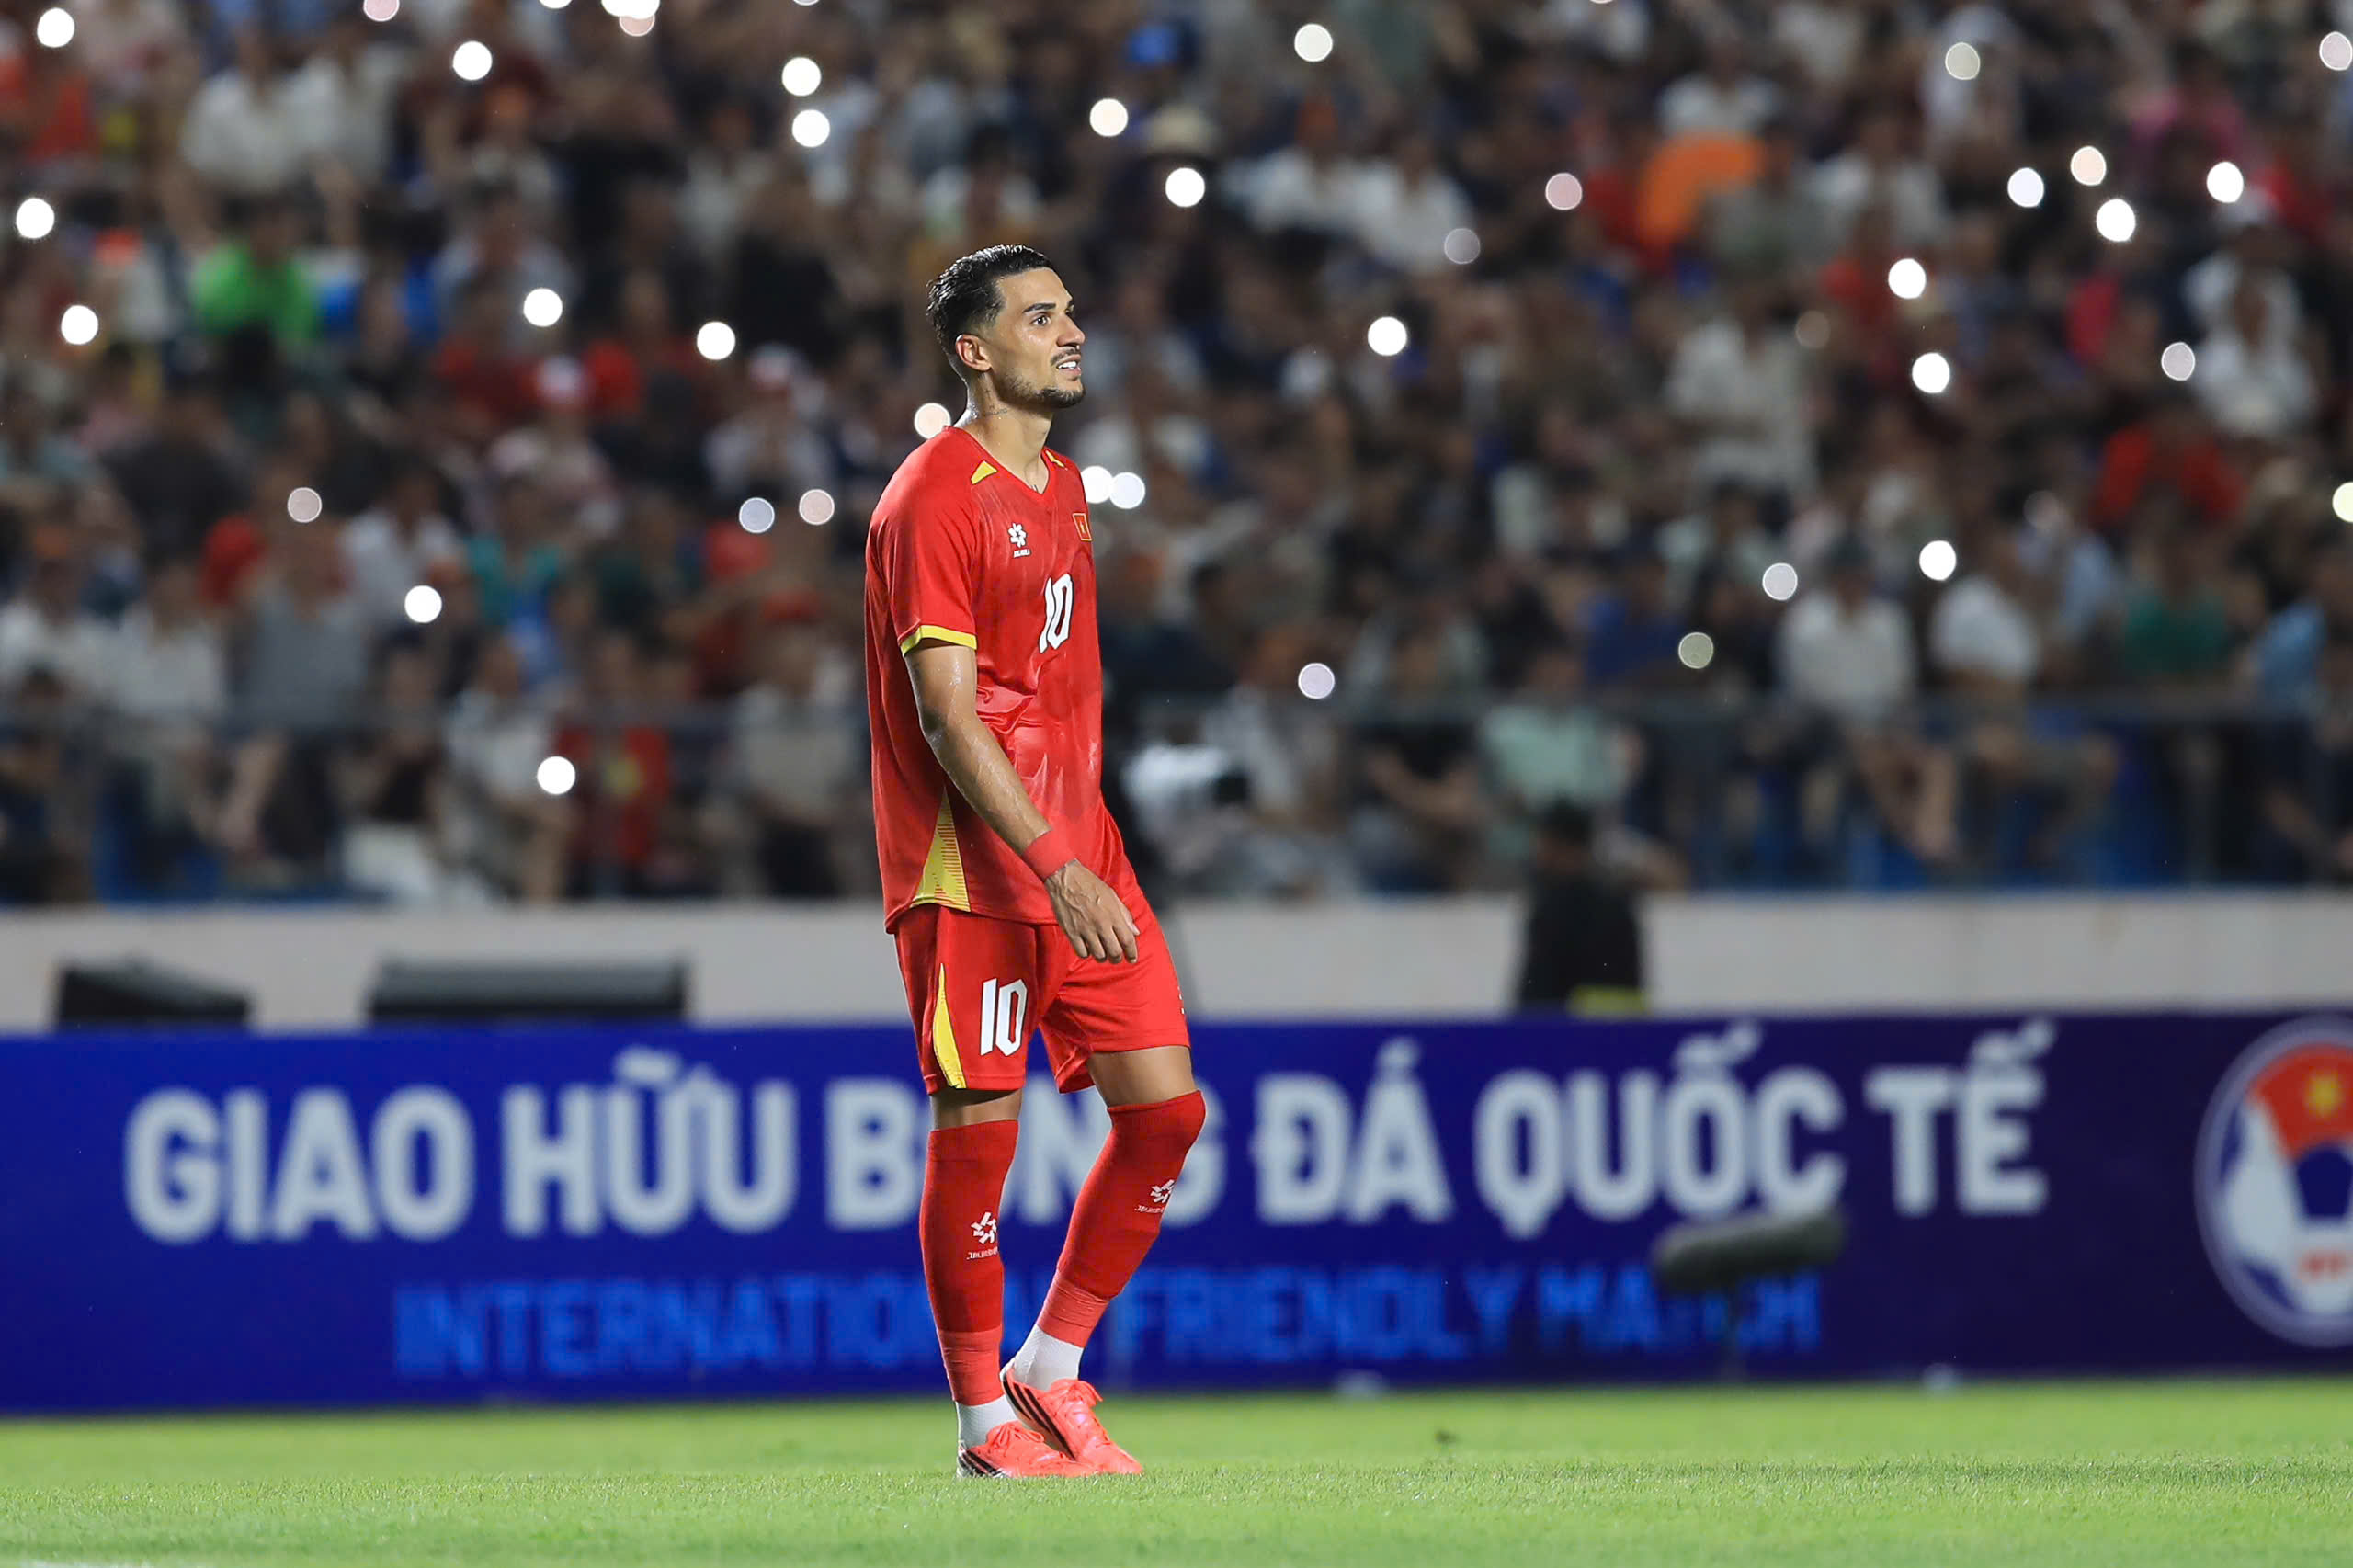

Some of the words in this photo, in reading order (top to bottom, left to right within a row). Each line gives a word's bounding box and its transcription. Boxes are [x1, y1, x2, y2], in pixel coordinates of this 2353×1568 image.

[1038, 573, 1074, 653] 10
[980, 978, 1028, 1057] 10
[124, 1085, 475, 1244] GIAO
[501, 1046, 798, 1237] HỮU
[824, 1074, 1227, 1230] BNG
[1251, 1039, 1452, 1223] ĐÁ
[1475, 1020, 1845, 1237] QUỐC
[1866, 1018, 2057, 1215] TẾ
